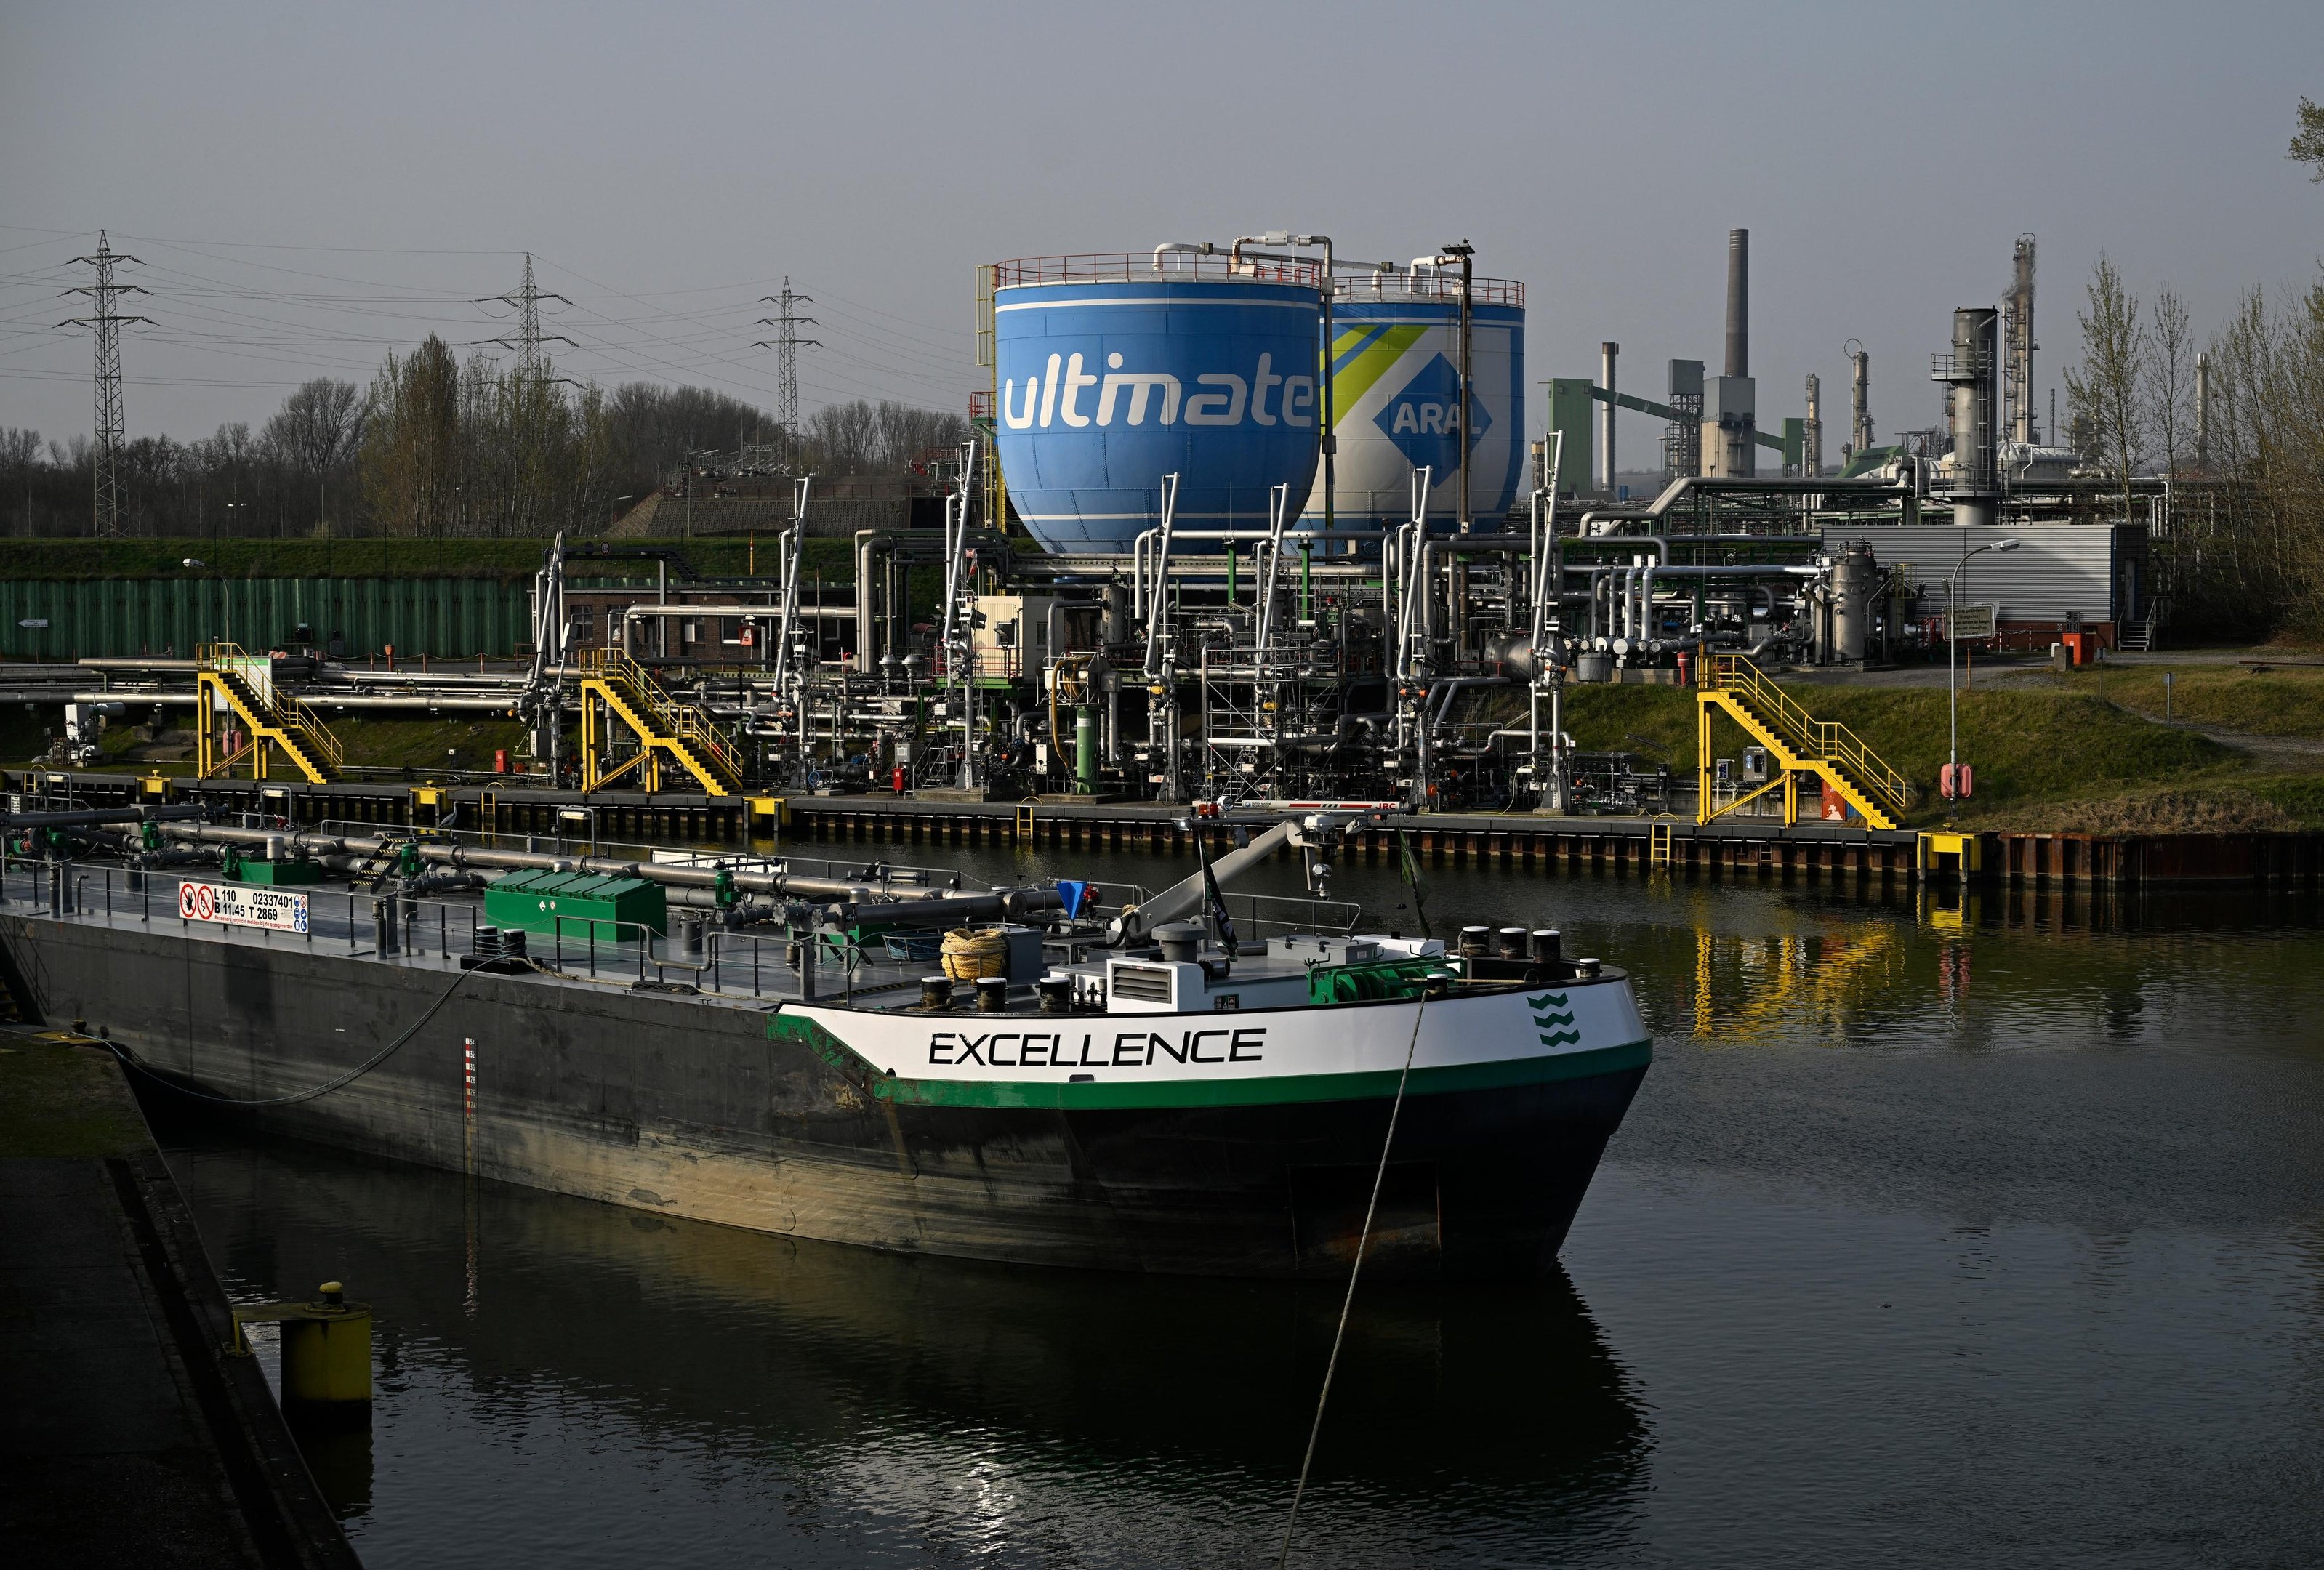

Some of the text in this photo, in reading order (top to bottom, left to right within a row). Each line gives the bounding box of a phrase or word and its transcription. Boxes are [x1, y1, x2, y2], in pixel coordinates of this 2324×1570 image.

[1004, 352, 1314, 430] ultimate
[214, 888, 293, 909] L 110 02337401
[214, 902, 220, 914] B
[222, 903, 245, 917] 11.45
[249, 906, 254, 918] T
[257, 908, 278, 921] 2869
[928, 1028, 1267, 1067] EXCELLENCE
